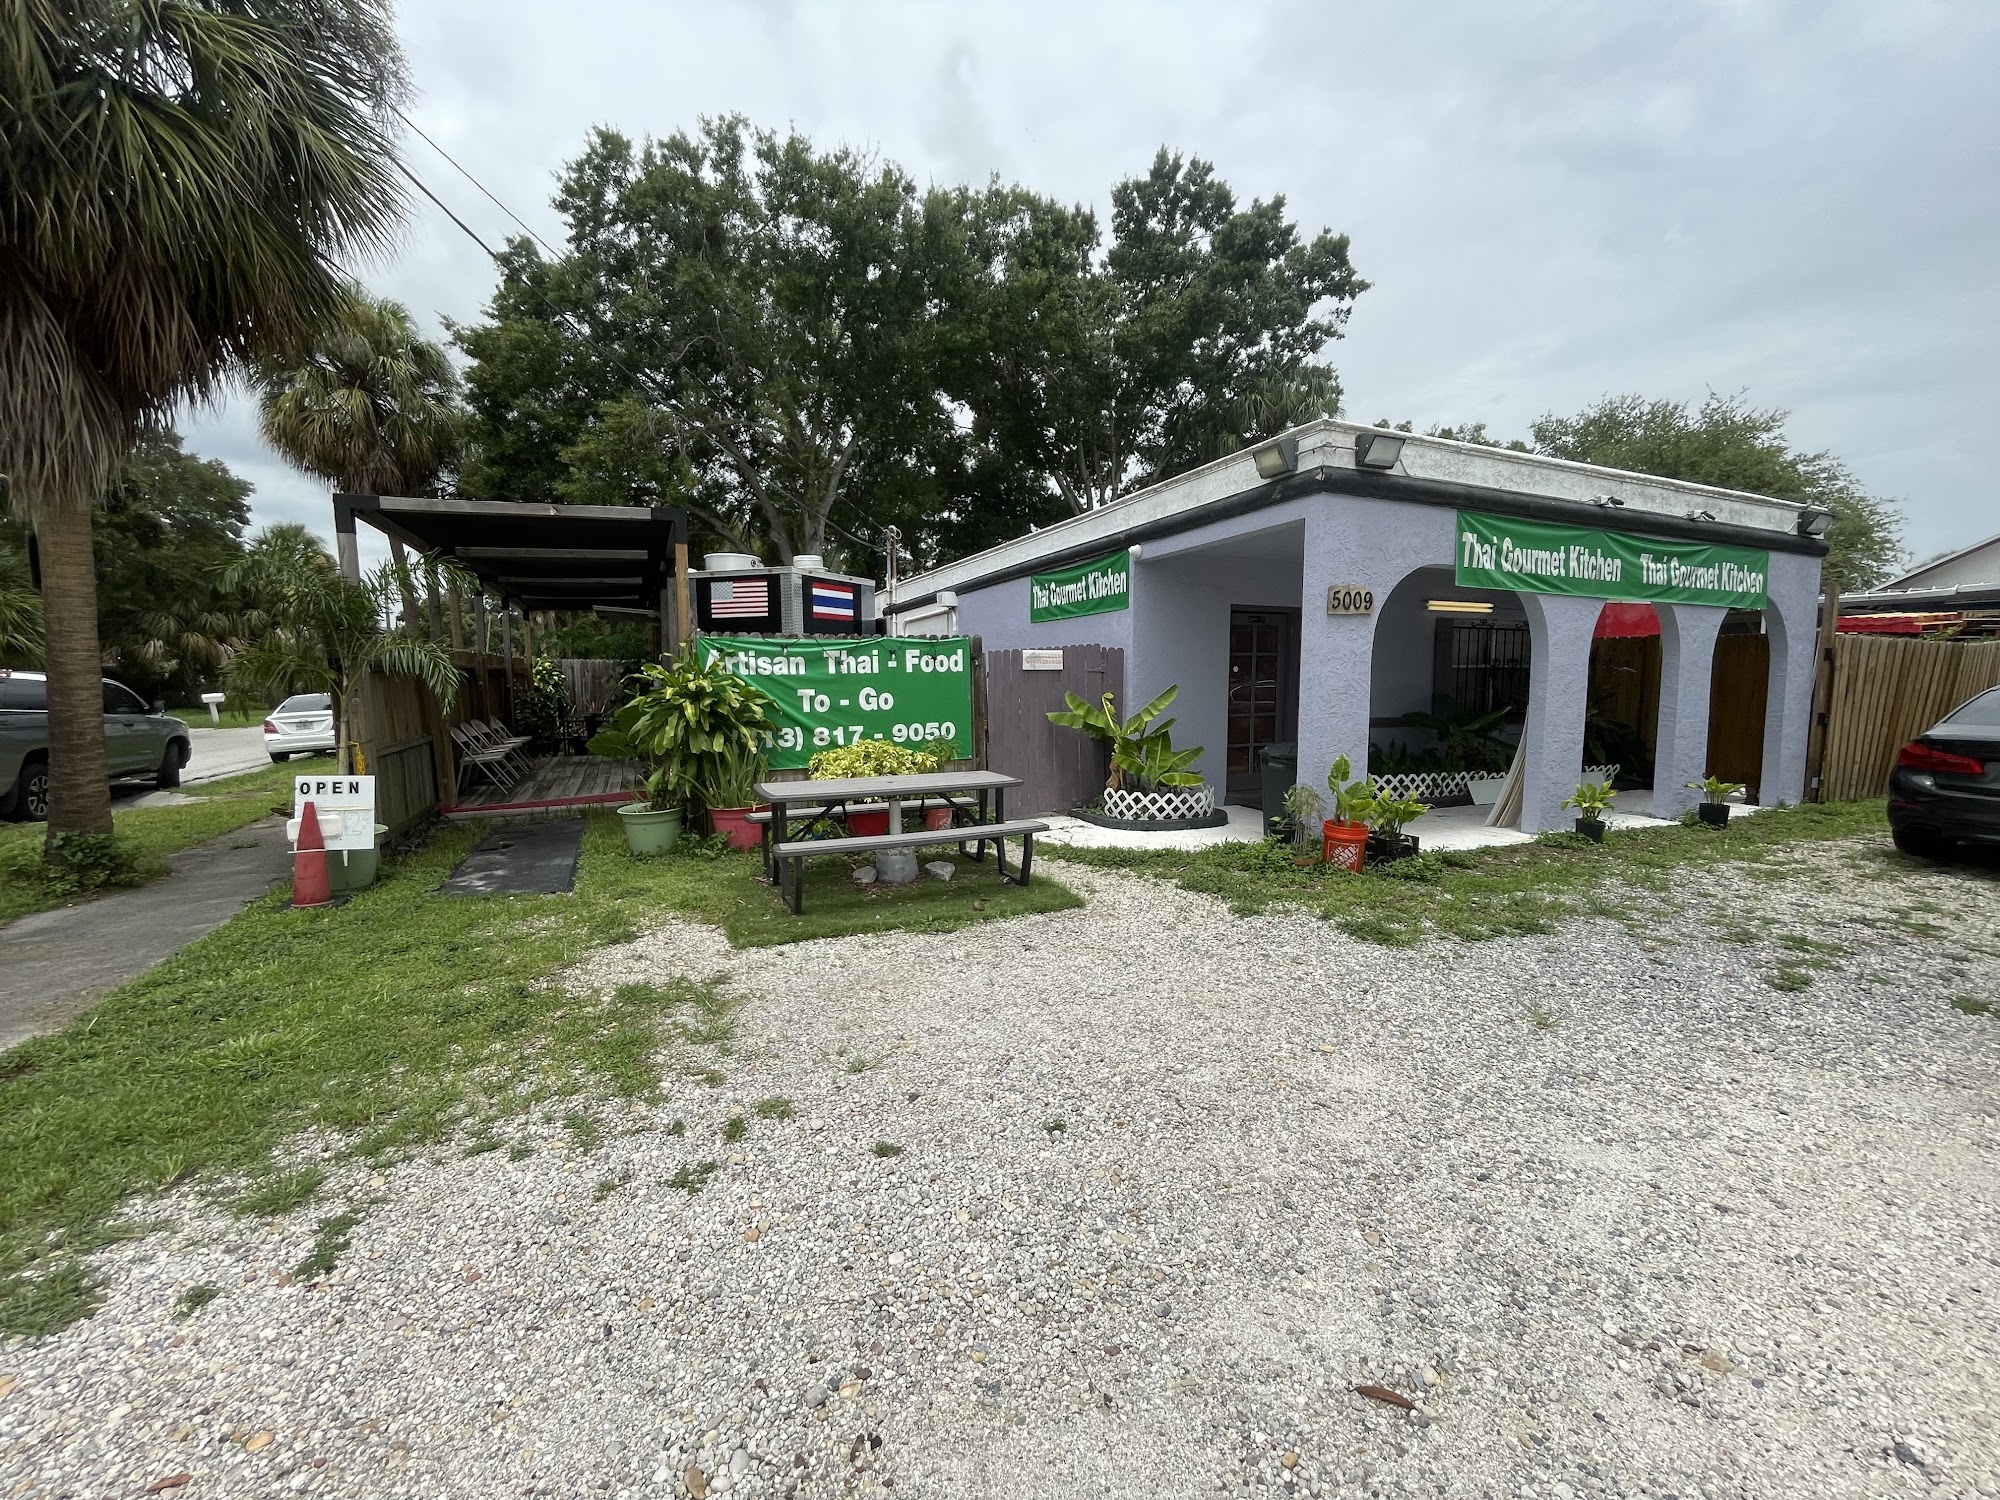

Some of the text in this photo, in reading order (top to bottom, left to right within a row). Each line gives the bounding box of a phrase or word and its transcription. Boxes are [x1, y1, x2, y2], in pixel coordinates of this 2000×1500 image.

[1462, 532, 1764, 594] Thai Gourmet Kitchen Thai Gourmet Kitchen
[1032, 568, 1127, 609] Thai Gourmet Kitchen
[1332, 589, 1373, 611] 5009
[824, 649, 880, 674] Thai
[905, 649, 964, 673] Food
[797, 689, 831, 713] To
[859, 687, 894, 711] Go
[813, 725, 864, 746] 817
[892, 721, 956, 742] 9050
[300, 781, 359, 795] OPEN
